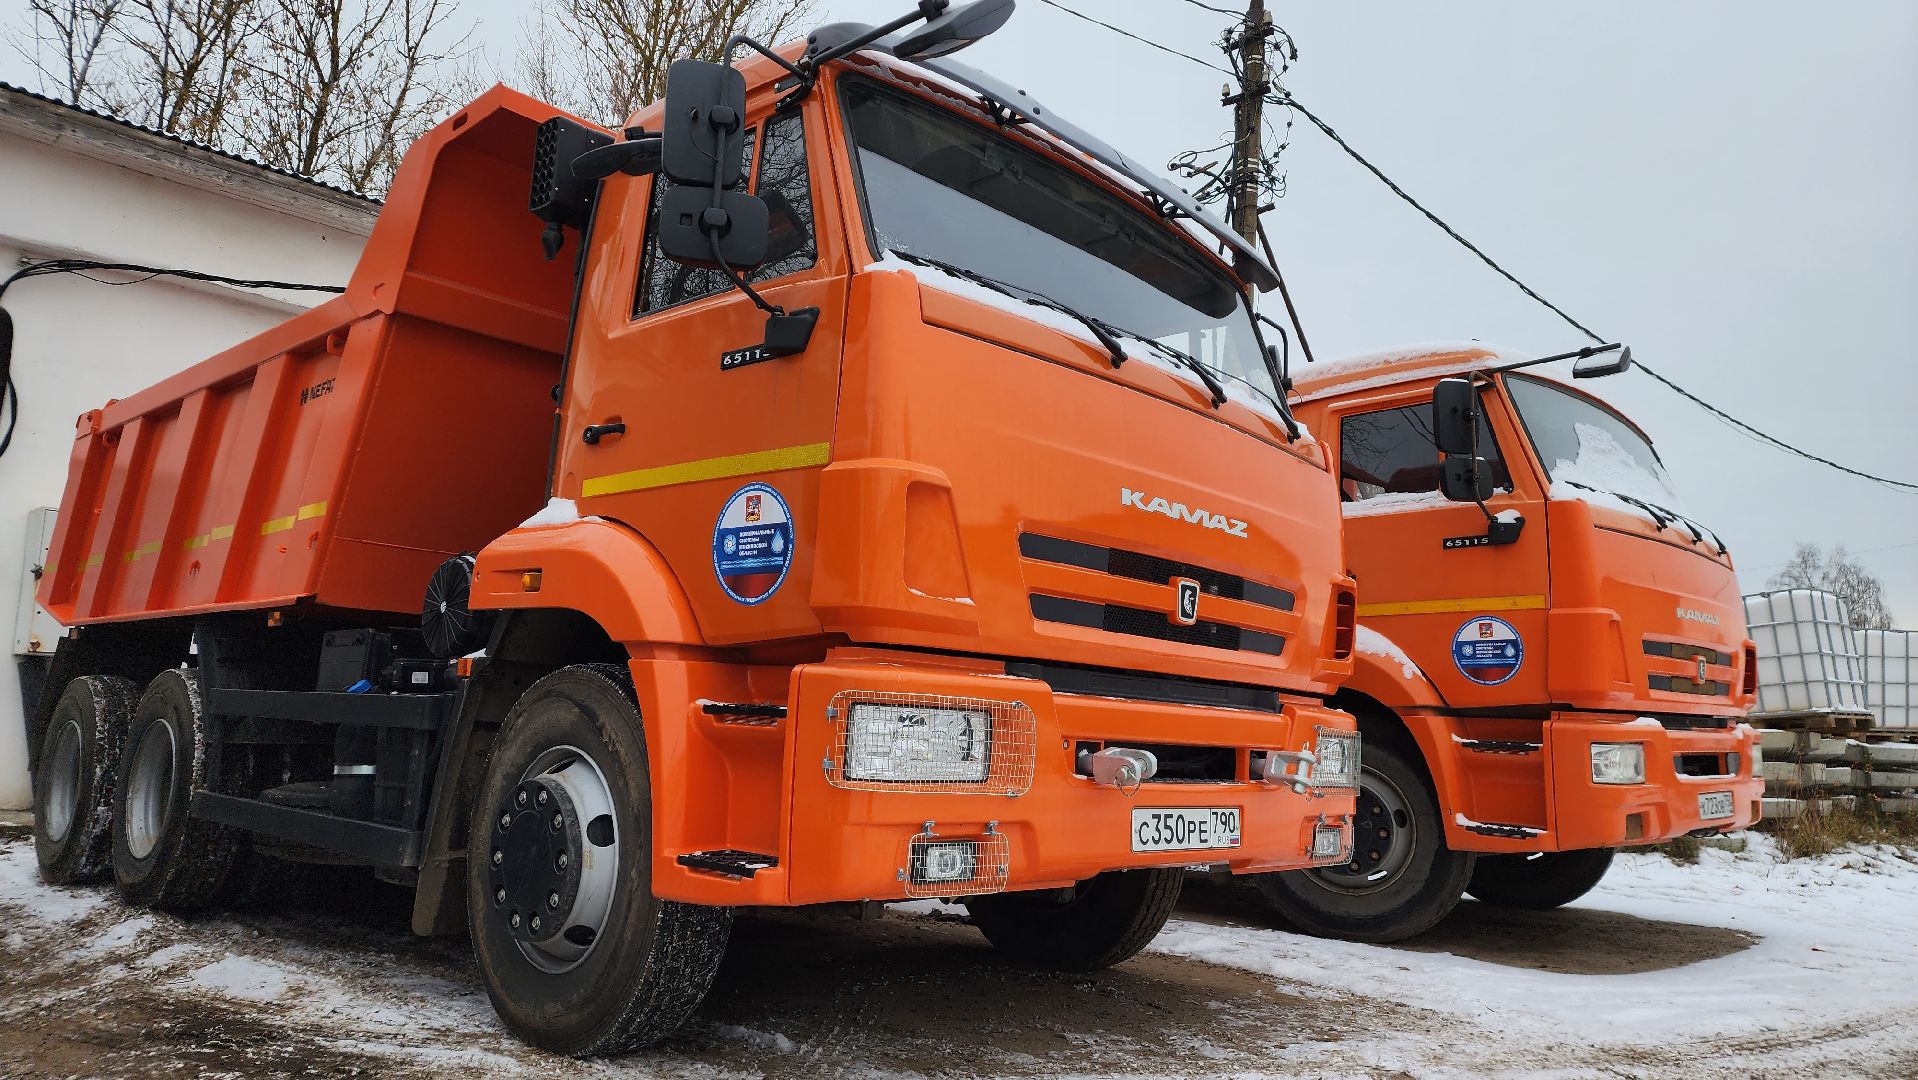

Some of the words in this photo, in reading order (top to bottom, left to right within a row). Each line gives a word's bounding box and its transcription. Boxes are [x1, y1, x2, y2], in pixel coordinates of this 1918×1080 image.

[1121, 487, 1248, 538] KAMAZ
[1446, 538, 1489, 547] 65115
[1211, 811, 1236, 833] 790
